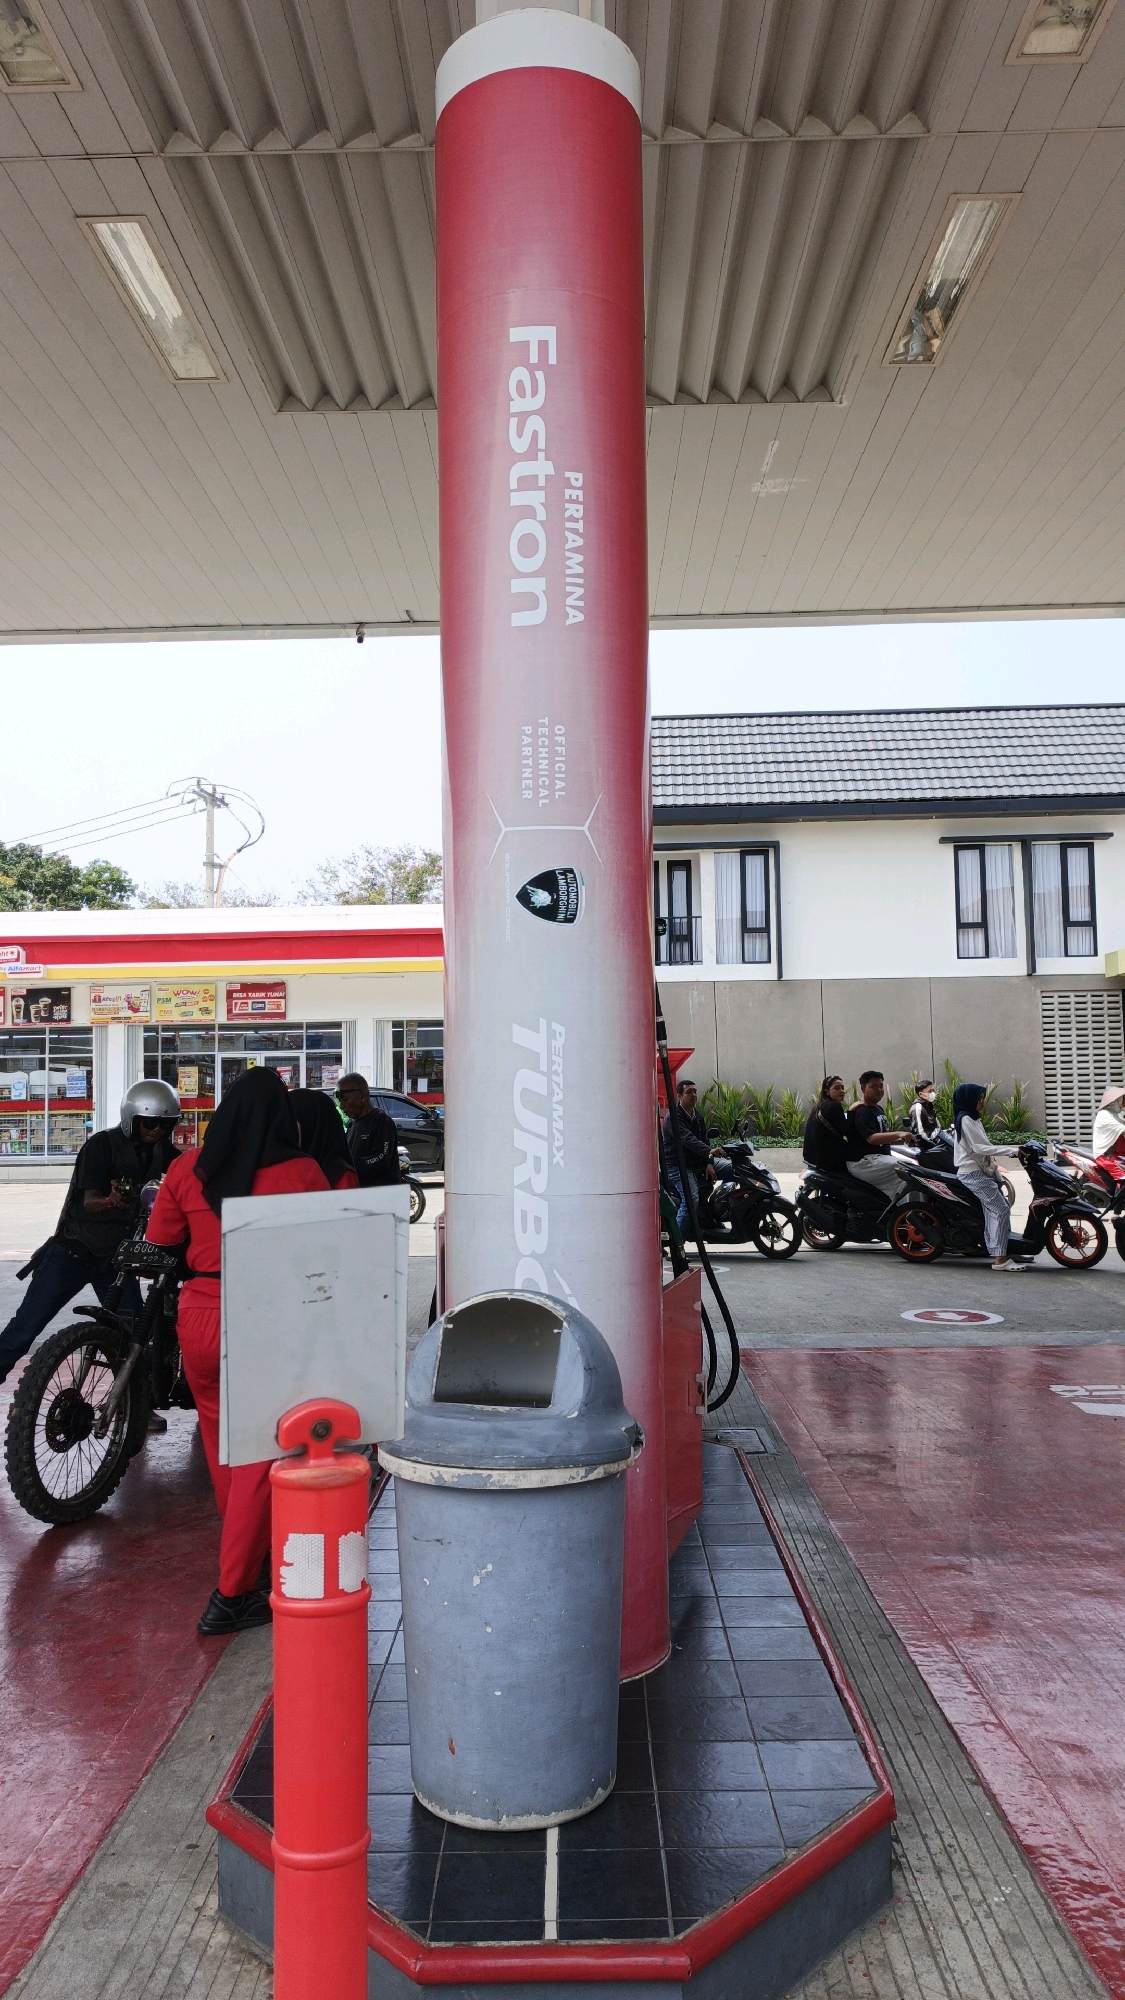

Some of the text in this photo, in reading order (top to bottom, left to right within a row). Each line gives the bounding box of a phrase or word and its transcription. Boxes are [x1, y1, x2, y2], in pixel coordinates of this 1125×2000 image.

[508, 325, 557, 627] Fastron
[564, 471, 585, 626] PERTAMINA
[521, 725, 533, 799] PARTNER
[537, 716, 549, 808] TECHNICAL
[554, 724, 566, 799] OFFICIAL
[555, 870, 568, 921] LAMBORGHINI
[566, 872, 578, 919] AUTOMOBILI
[550, 1021, 566, 1168] PERTAMAX
